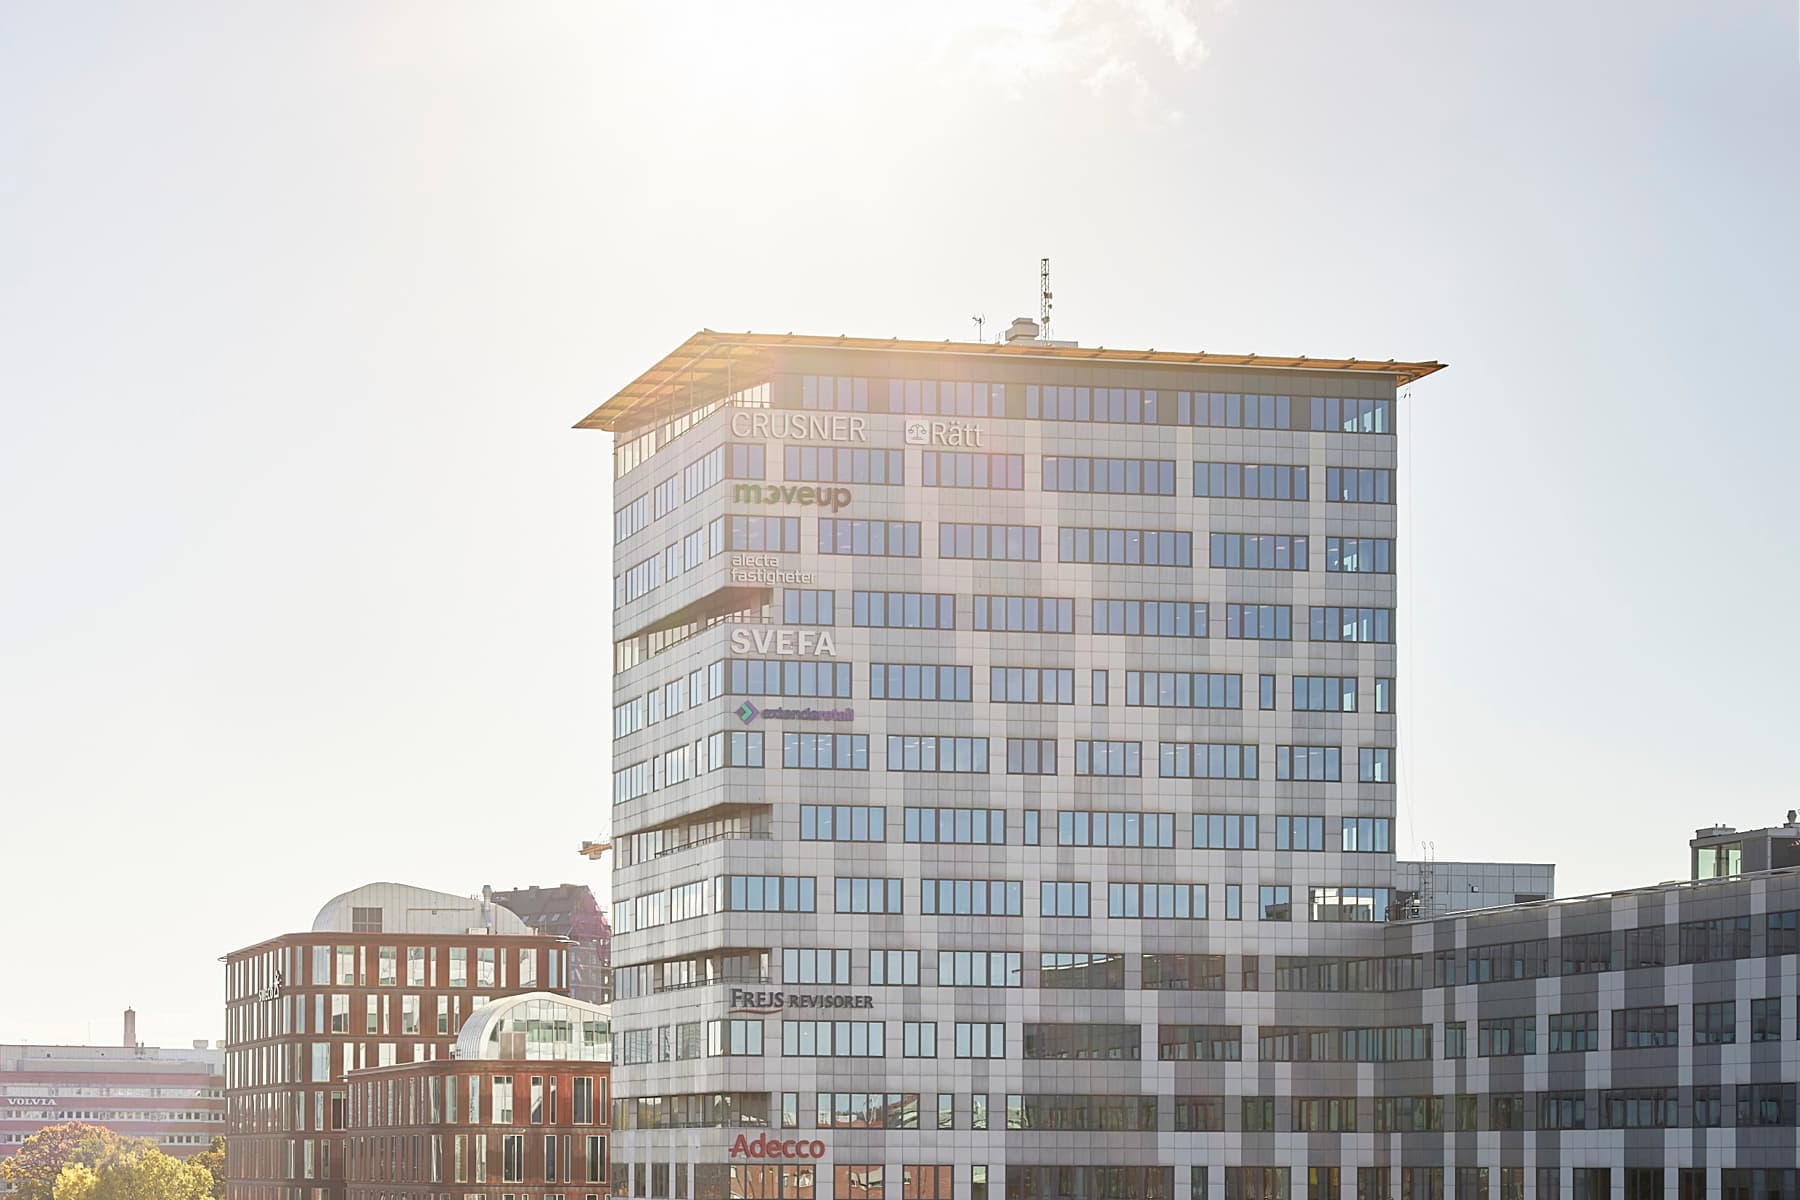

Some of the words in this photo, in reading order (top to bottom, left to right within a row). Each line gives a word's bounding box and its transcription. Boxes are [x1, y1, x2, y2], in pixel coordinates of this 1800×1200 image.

[731, 412, 867, 441] CRUSNER
[931, 421, 985, 448] Rätt
[731, 553, 780, 567] alecta
[730, 568, 816, 585] fastigheter
[731, 628, 837, 657] SVEFA
[730, 988, 785, 1008] FREJS
[788, 994, 874, 1009] REVISORER
[8, 1098, 57, 1106] VOLVIA
[728, 1132, 825, 1159] Adecco
